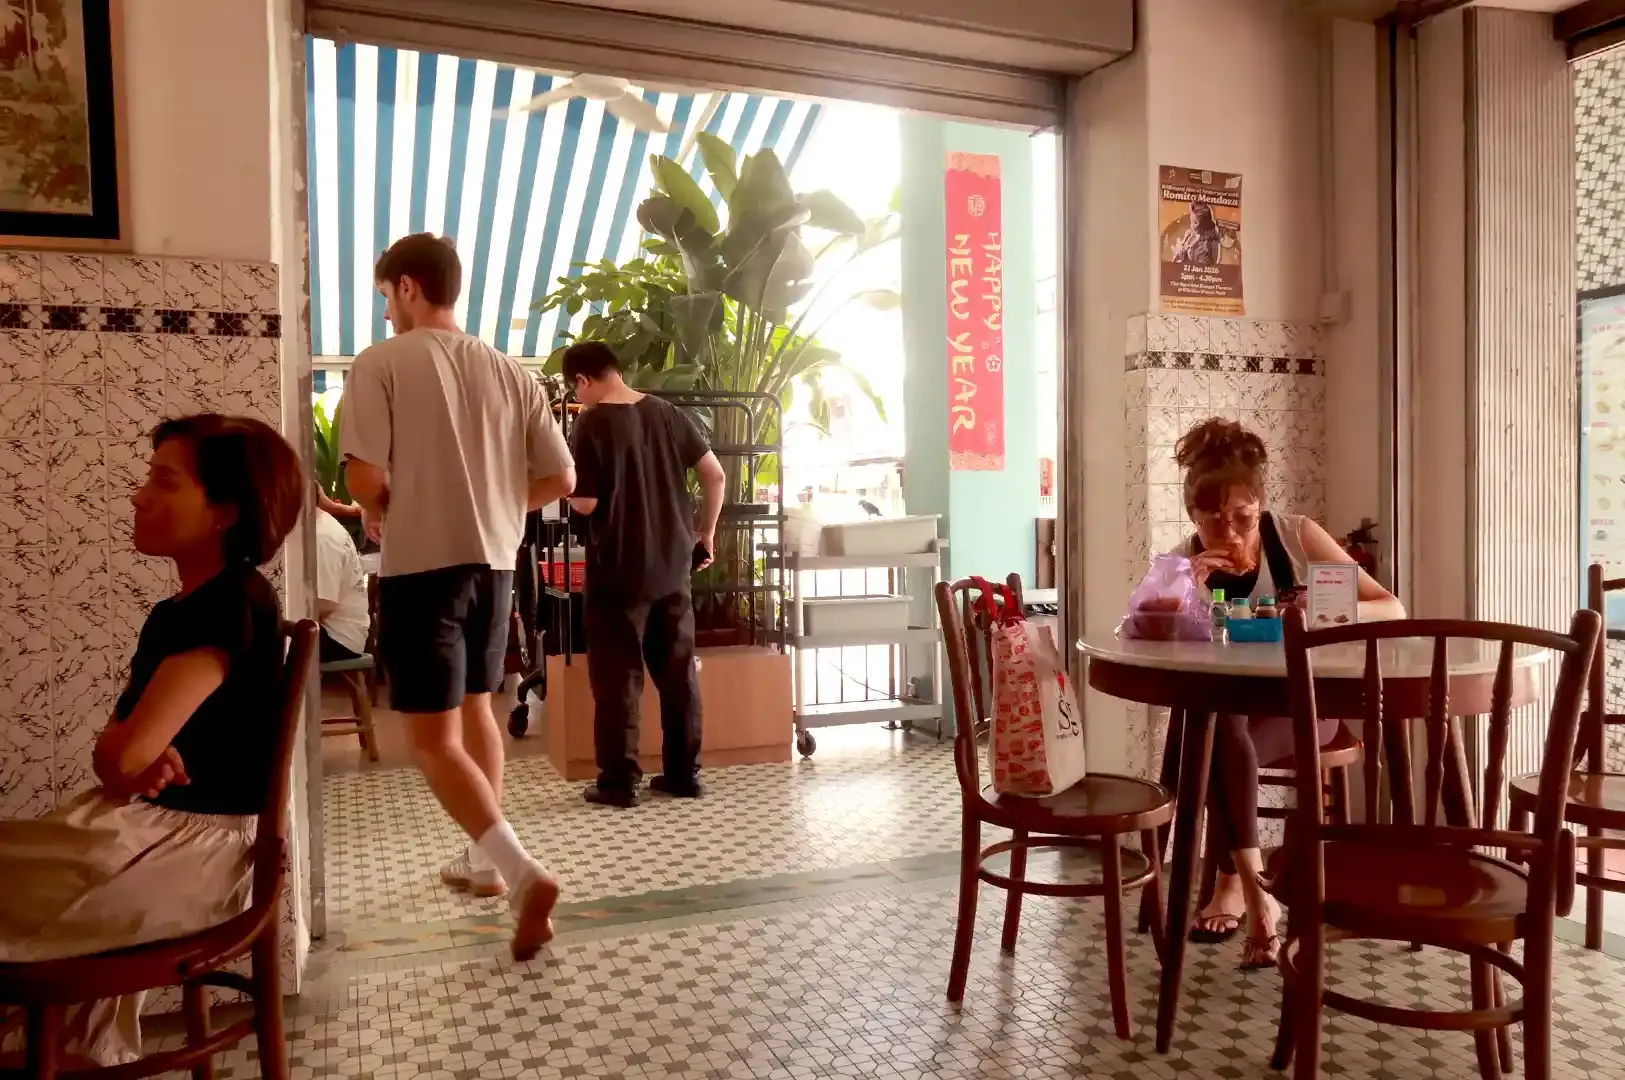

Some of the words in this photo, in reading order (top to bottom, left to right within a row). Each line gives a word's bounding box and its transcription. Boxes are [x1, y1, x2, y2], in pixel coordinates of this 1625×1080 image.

[1163, 189, 1197, 201] Romito
[1197, 194, 1238, 206] Mendoza
[948, 234, 973, 320] NEW
[981, 232, 1001, 330] HAPPY
[1181, 273, 1195, 281] 3pm
[1199, 274, 1222, 283] 4.30pm
[946, 332, 976, 434] YEAR
